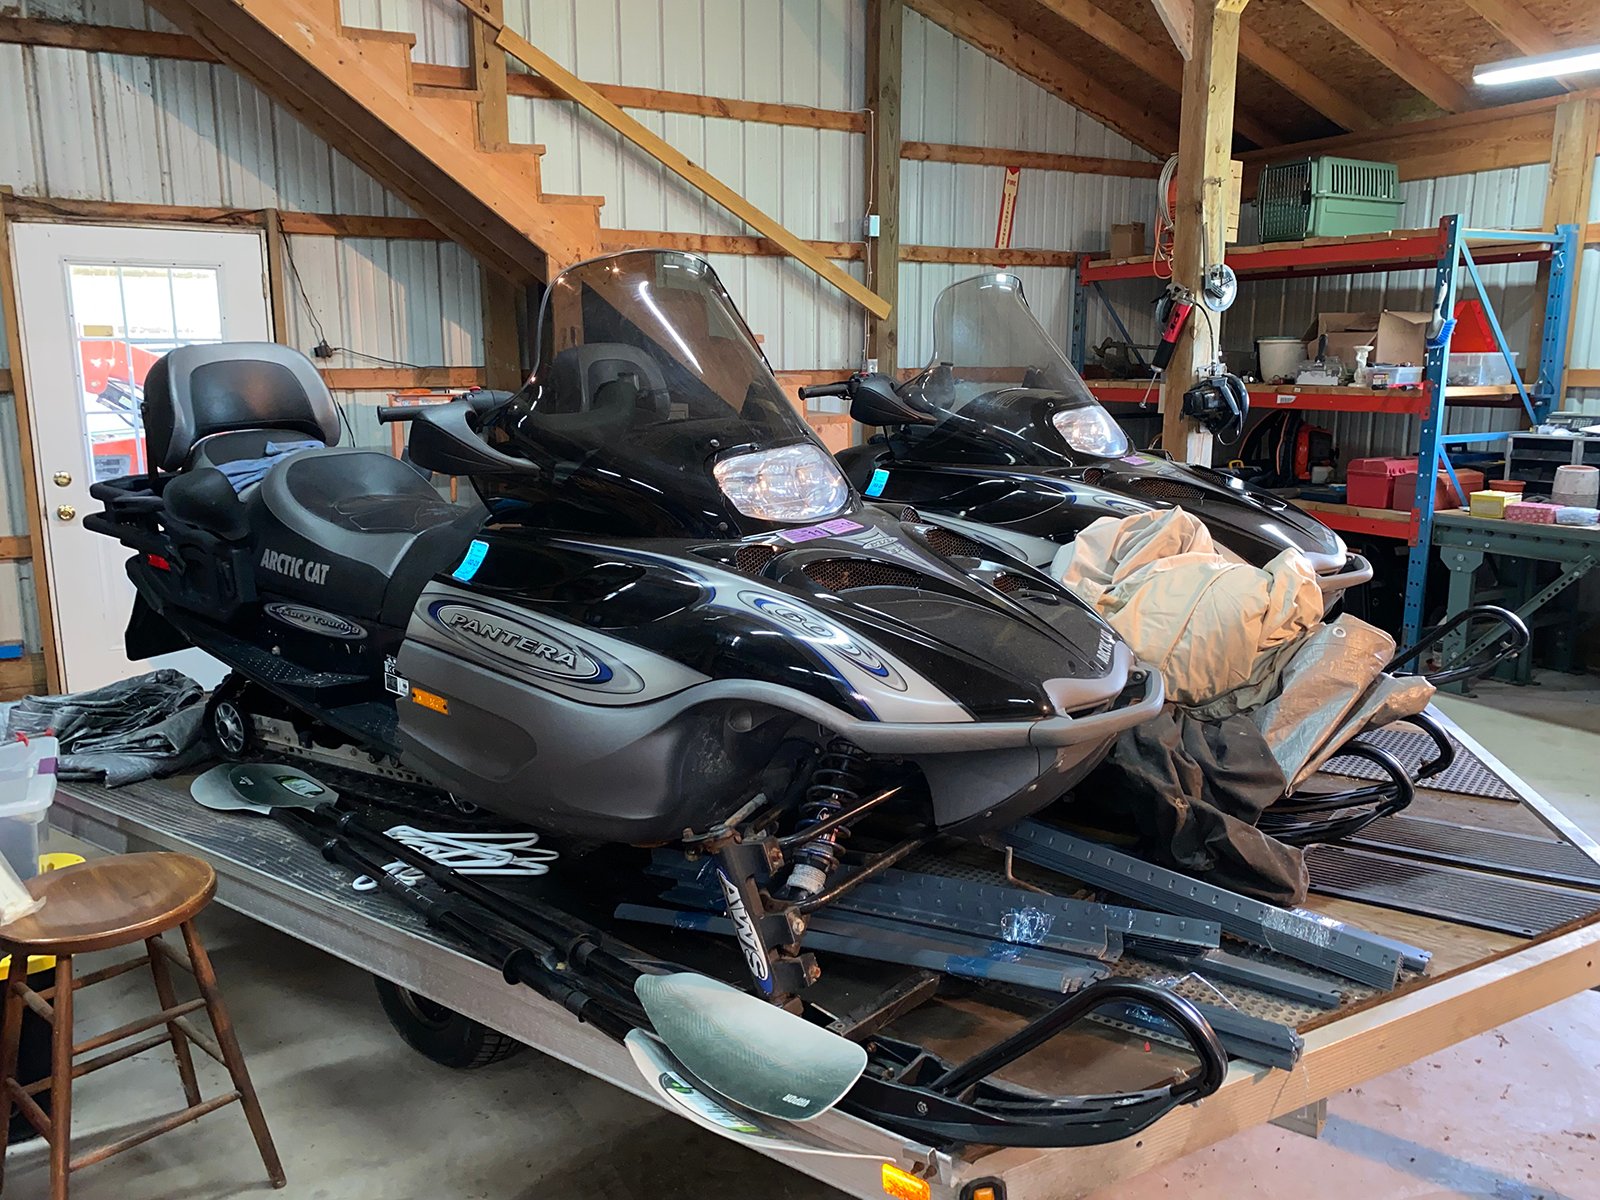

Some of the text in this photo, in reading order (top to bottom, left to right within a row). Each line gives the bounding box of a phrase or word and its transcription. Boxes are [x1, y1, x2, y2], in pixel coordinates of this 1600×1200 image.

[1007, 179, 1017, 187] FIRE
[1001, 192, 1012, 245] EXTINGUISHER
[260, 548, 331, 585] ARCTIC CAT
[269, 605, 361, 635] Luxury Touring
[449, 613, 578, 670] PANTERA
[716, 867, 768, 981] AWS
